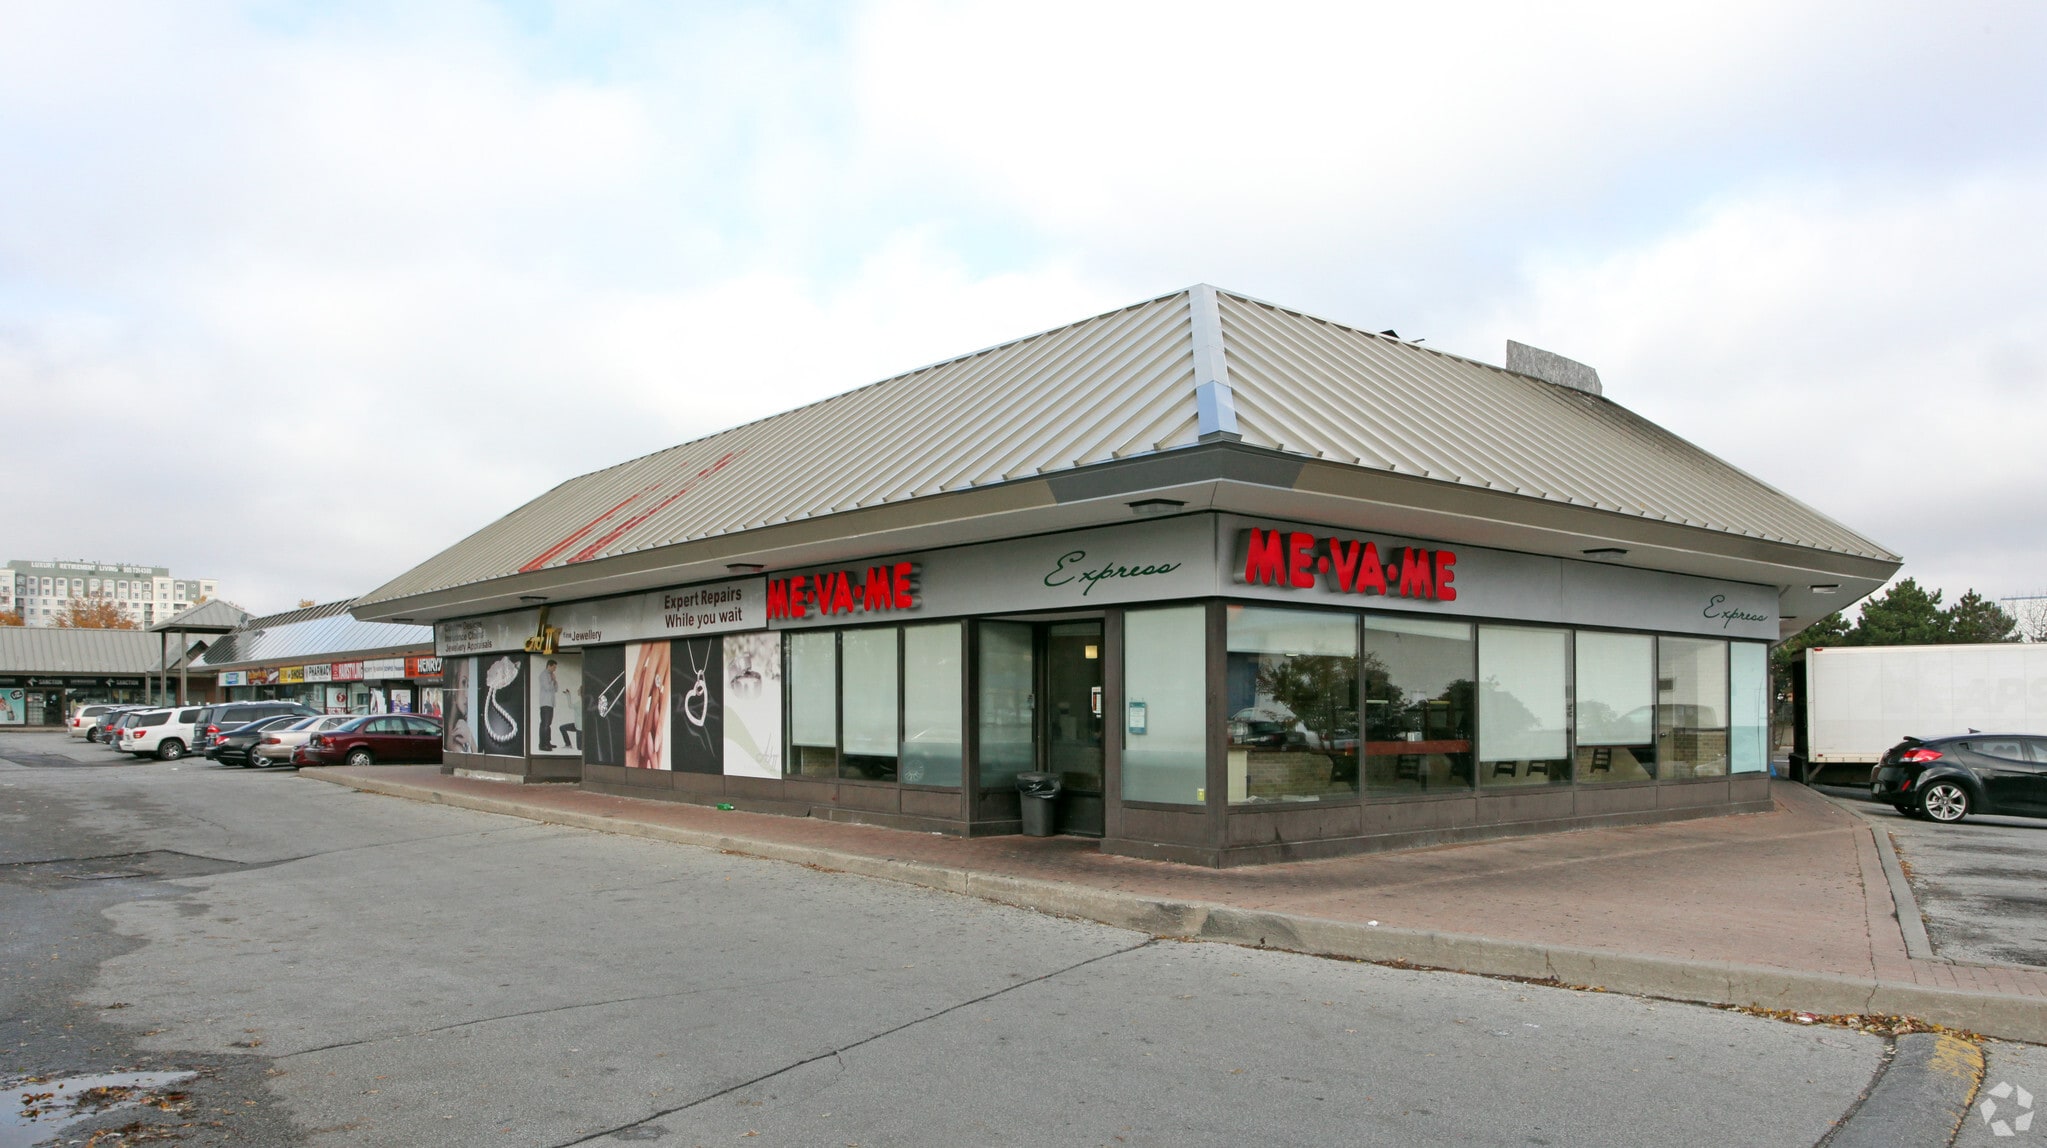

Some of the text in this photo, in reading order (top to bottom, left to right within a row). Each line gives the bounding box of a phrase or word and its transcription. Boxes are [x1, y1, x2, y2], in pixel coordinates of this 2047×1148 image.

[59, 562, 96, 571] RETIREMENT
[1044, 550, 1182, 596] Express
[664, 587, 742, 611] Expert Repairs
[665, 606, 743, 629] While you wait
[1703, 594, 1768, 629] Express
[571, 629, 602, 641] Jewellery
